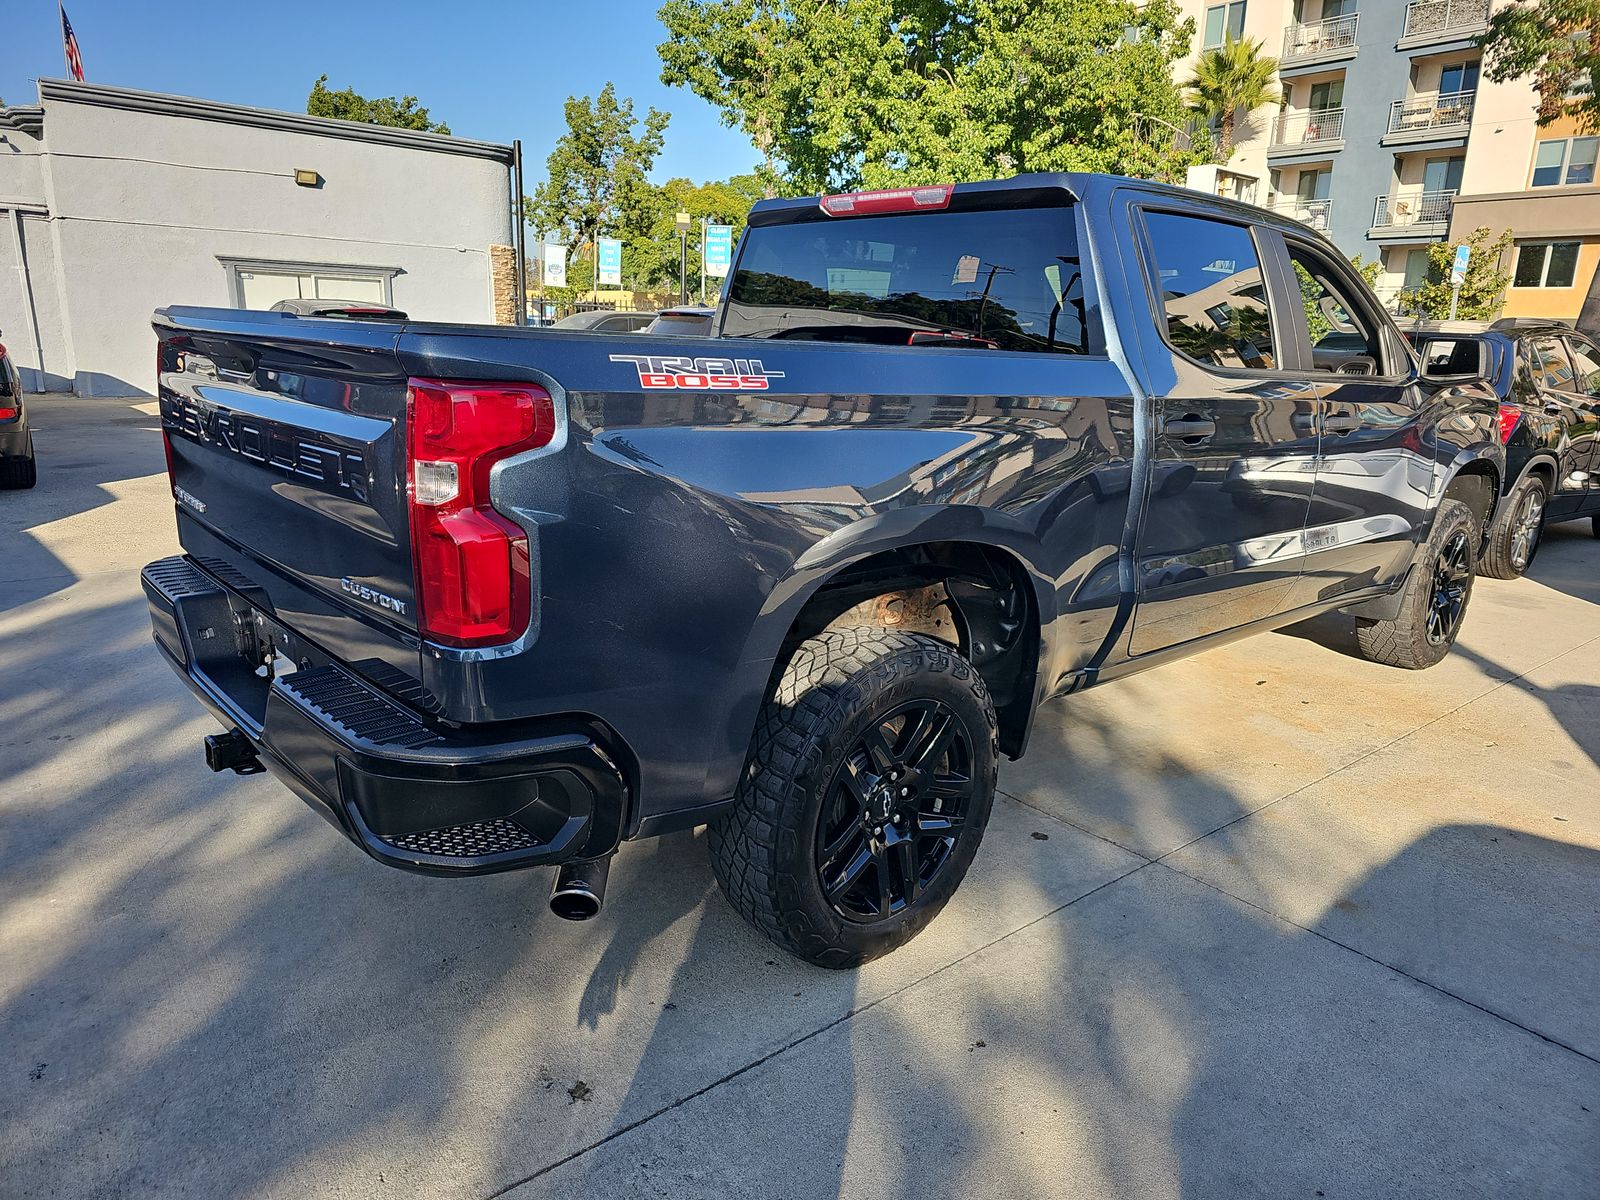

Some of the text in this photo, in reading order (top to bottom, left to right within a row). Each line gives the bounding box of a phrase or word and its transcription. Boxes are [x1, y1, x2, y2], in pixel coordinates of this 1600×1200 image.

[608, 354, 786, 378] TRAIL
[639, 373, 770, 390] BOSS
[340, 577, 406, 614] CUSTOM
